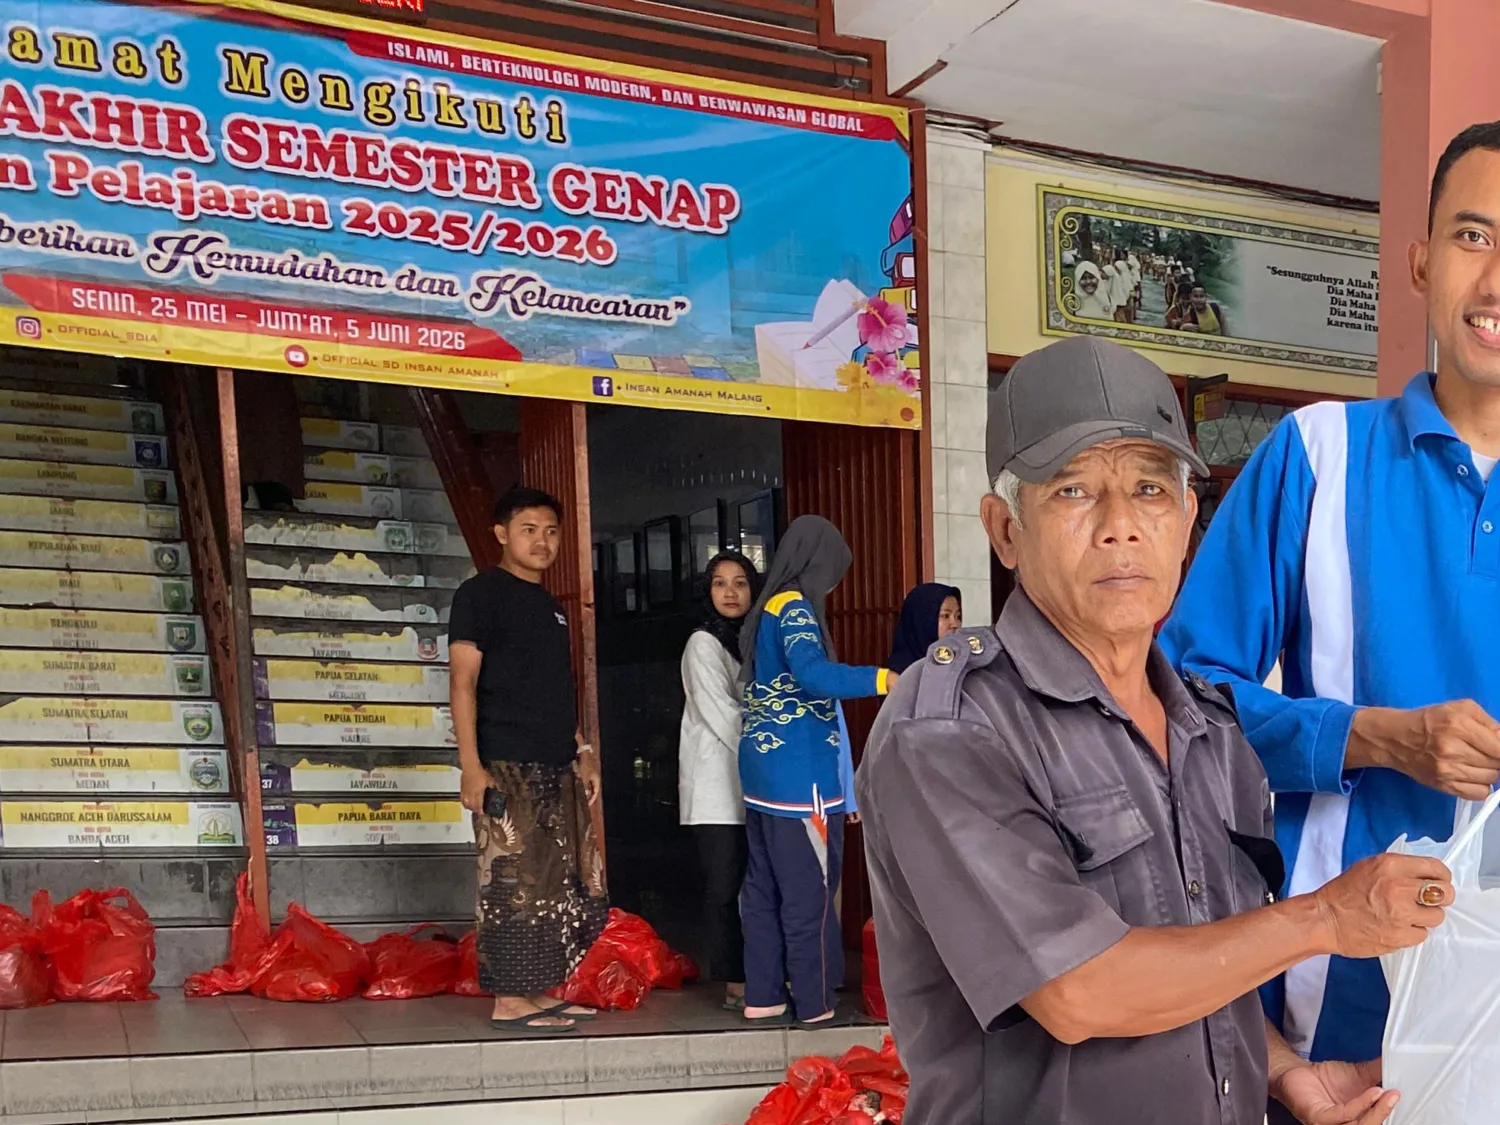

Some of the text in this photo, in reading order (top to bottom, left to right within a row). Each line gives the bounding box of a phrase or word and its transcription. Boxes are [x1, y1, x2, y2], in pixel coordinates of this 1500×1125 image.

[387, 41, 864, 132] ISLAMI, BERTEKNOLOGI MODERN, DAN BERWAWASAN GLOBAL
[222, 48, 567, 143] Mengikuti
[0, 84, 738, 231] AKHIR SEMESTER GENAP
[49, 152, 330, 229] Pelajaran
[344, 202, 615, 264] 2025/2026
[147, 234, 385, 290] Kemudahan
[395, 269, 460, 299] dan
[1347, 278, 1374, 290] Allah
[1327, 285, 1344, 296] Dia
[1346, 288, 1373, 300] Maha
[1330, 297, 1376, 311] Dia Maha
[1329, 307, 1375, 321] Dia Maha
[151, 297, 178, 318] 25
[186, 301, 227, 324] MEI
[347, 320, 360, 339] 5
[367, 322, 410, 344] JUNI
[418, 328, 466, 350] 2026
[1327, 317, 1379, 332] karena itu
[58, 325, 158, 344] OFFICIAL_SDIA
[322, 354, 499, 379] OFFICIAL SD INSAN AMANAH
[315, 671, 378, 681] PAPUA SELATAN
[42, 707, 87, 718] SUMATRA
[324, 714, 386, 723] PAPUA TENGAH
[51, 758, 130, 767] SUMATRA UTARA
[76, 780, 109, 789] MEDAN
[262, 779, 273, 789] 37
[20, 812, 171, 822] NANGGROE ACEH DARUSSALAM
[338, 812, 422, 821] PAPUA BARAT DAYA
[105, 835, 130, 844] ACEH
[266, 835, 280, 845] 38
